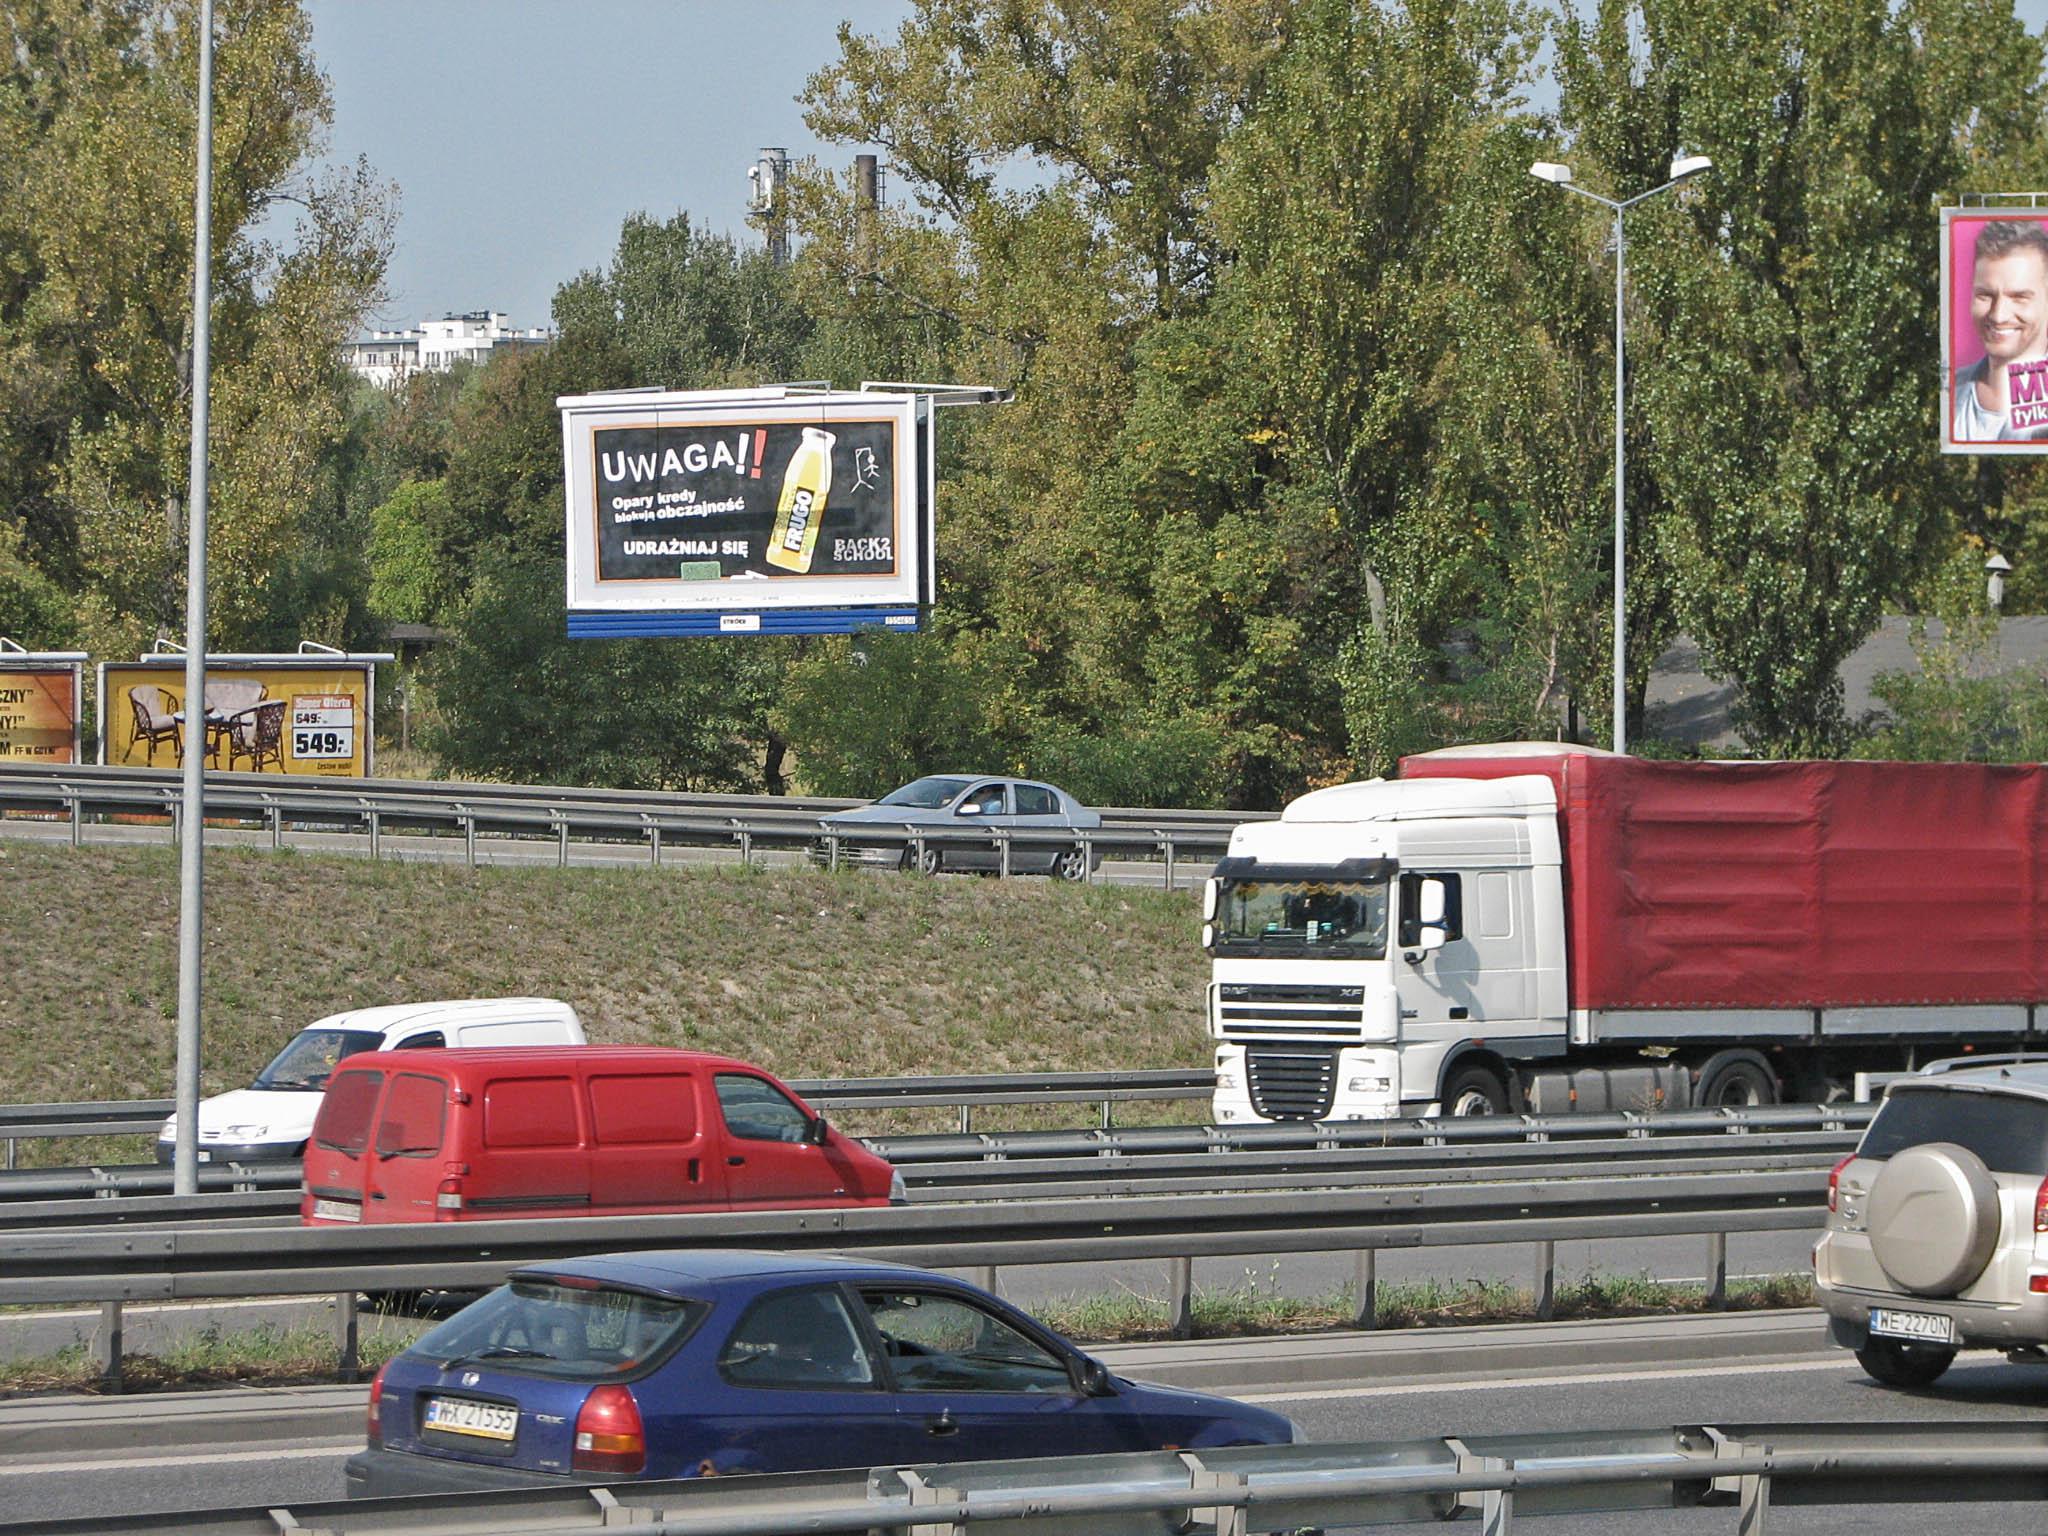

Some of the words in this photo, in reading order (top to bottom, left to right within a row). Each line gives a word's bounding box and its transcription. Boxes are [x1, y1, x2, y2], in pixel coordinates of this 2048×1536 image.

[601, 428, 768, 482] UWAGA!!
[612, 495, 654, 511] Opary
[657, 489, 697, 504] kredy
[614, 509, 656, 524] blokują
[656, 496, 746, 519] obczajność
[784, 489, 814, 551] FRUGO
[623, 537, 718, 556] UDRAŻNIAJ
[721, 540, 749, 558] SIĘ
[833, 547, 894, 562] SCHOOL
[1221, 985, 1249, 996] DAF
[1339, 988, 1363, 997] XF
[1880, 1310, 1900, 1330] WE
